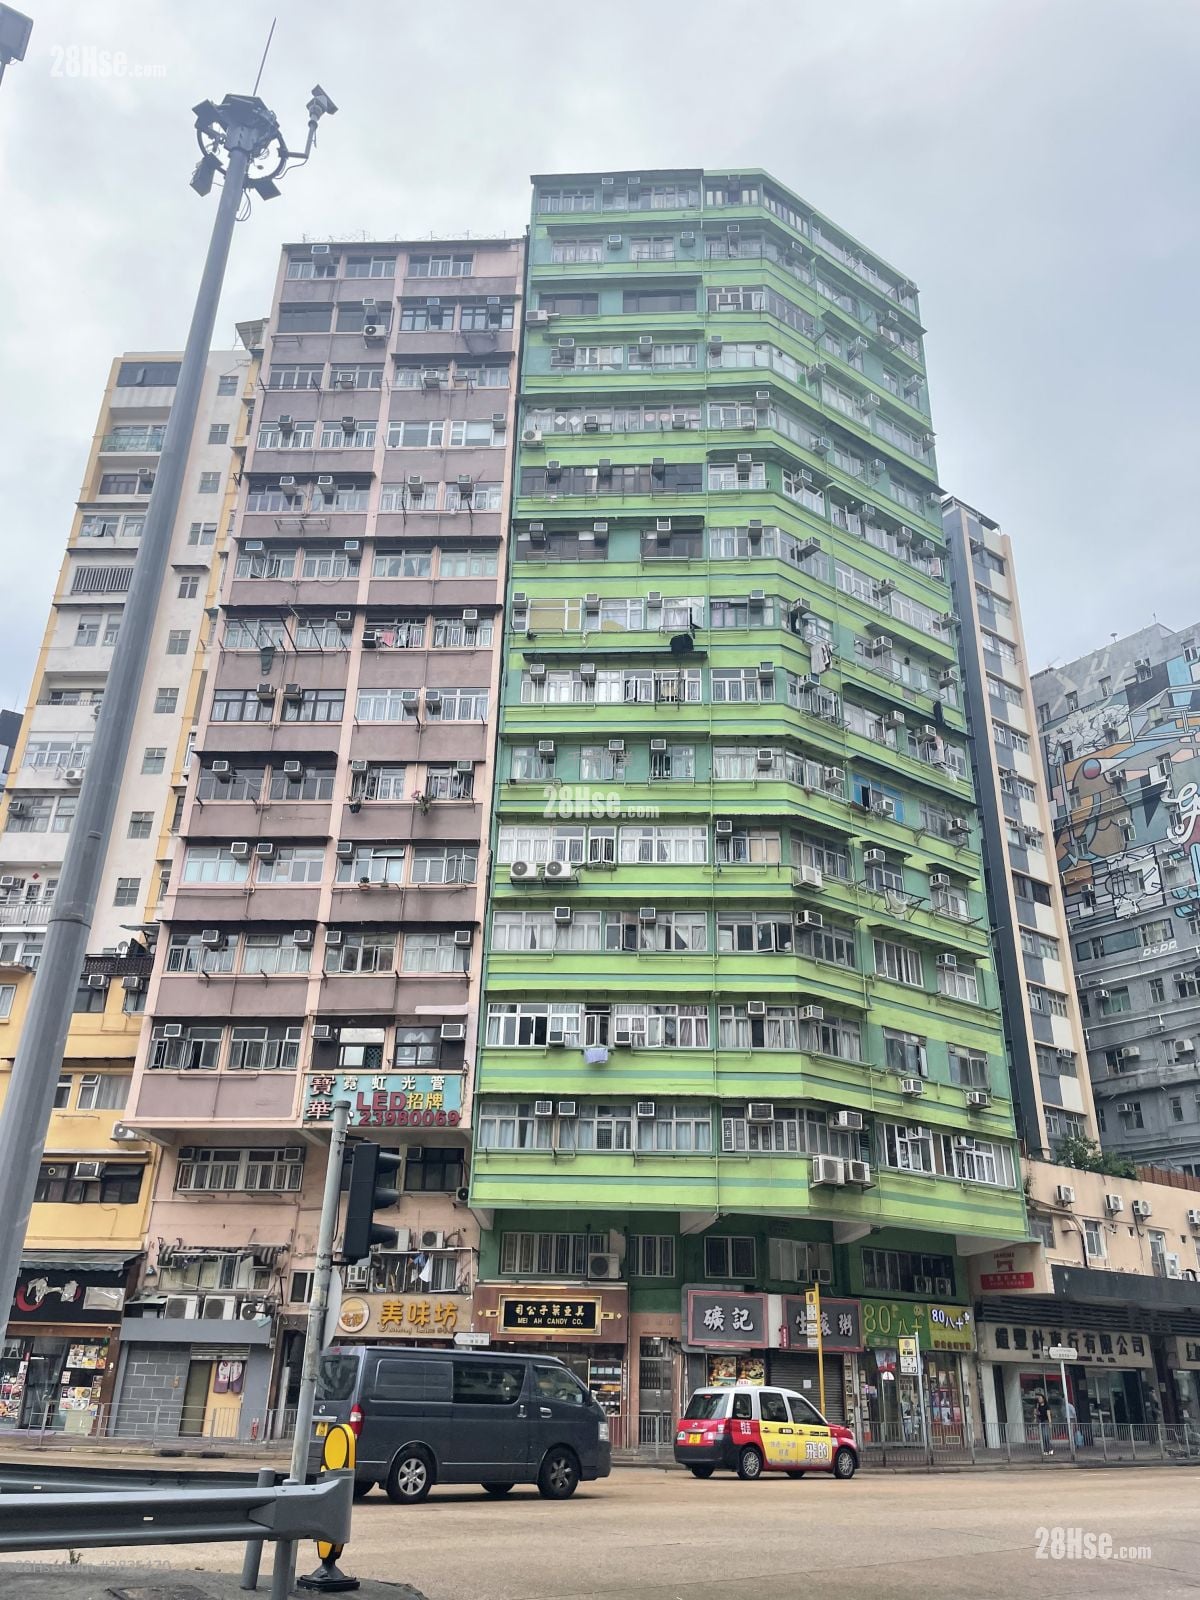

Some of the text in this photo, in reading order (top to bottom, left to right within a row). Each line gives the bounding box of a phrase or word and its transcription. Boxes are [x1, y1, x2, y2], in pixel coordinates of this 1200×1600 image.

[343, 1075, 445, 1091] 霓虹光管
[358, 1110, 461, 1126] 23980069
[381, 1300, 459, 1327] 美味坊
[546, 1317, 568, 1325] CANDY
